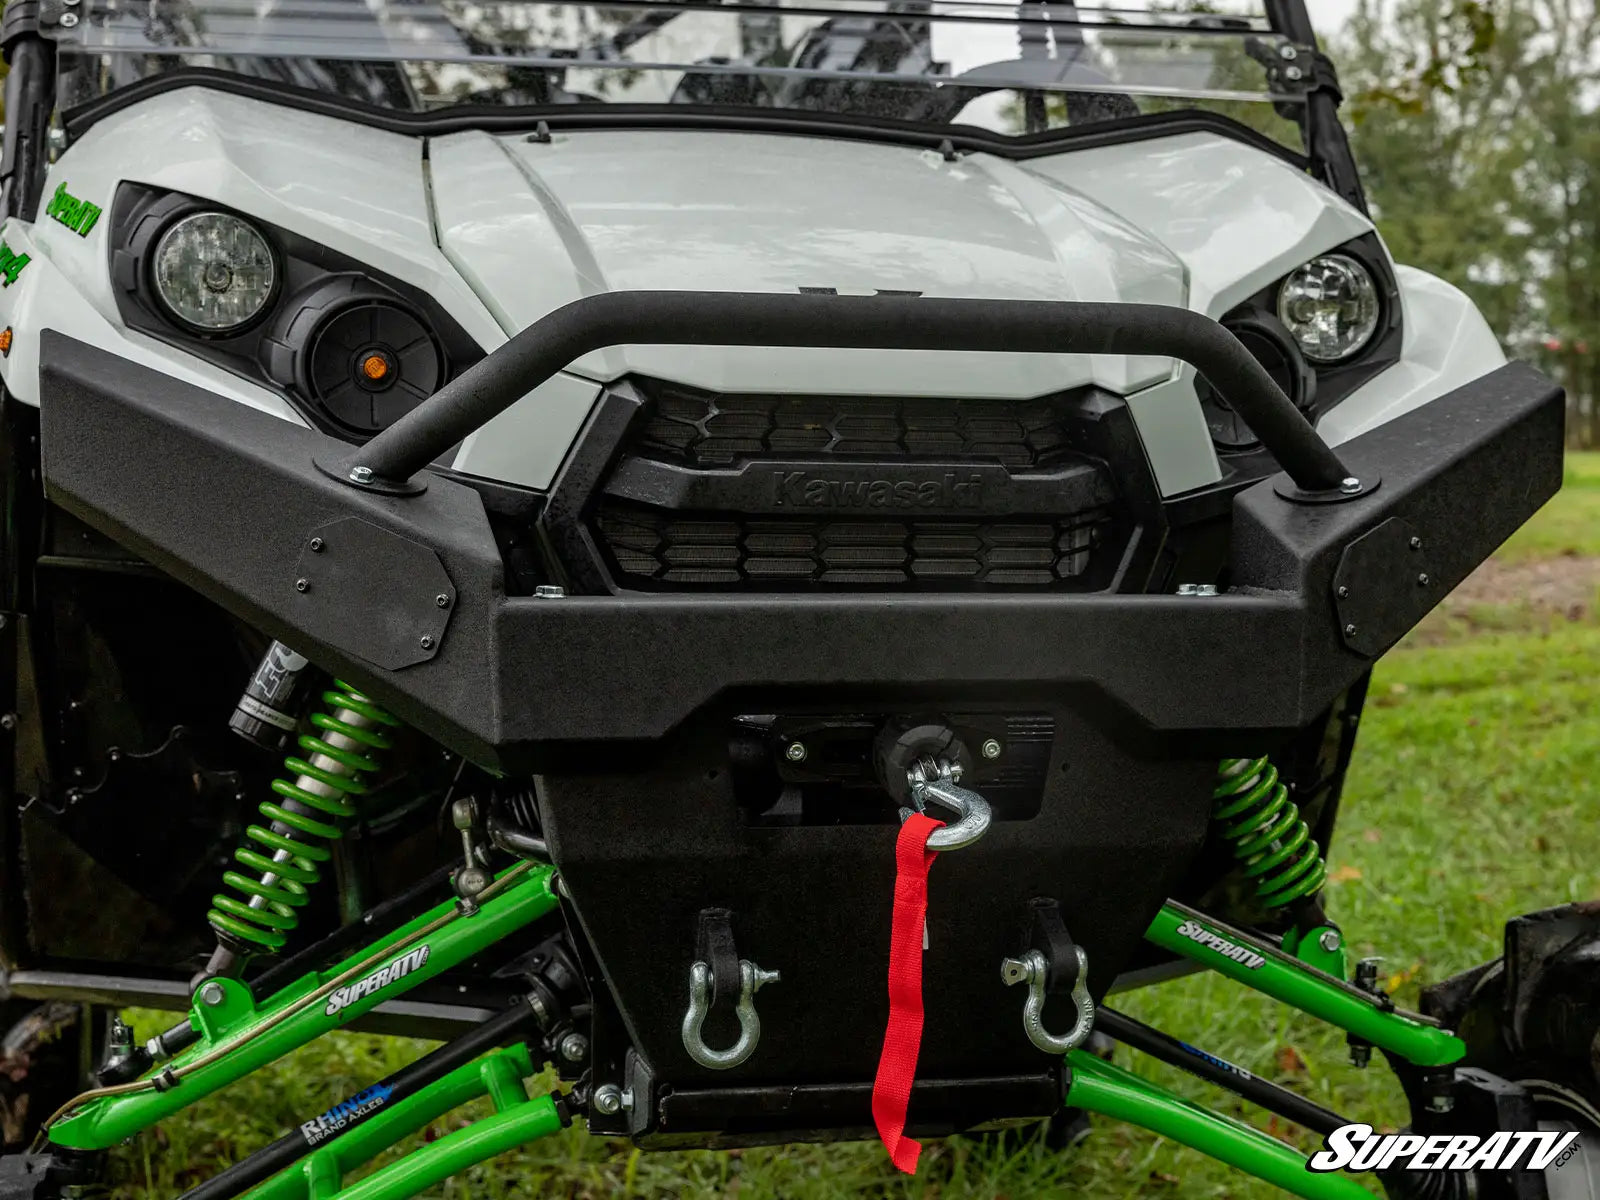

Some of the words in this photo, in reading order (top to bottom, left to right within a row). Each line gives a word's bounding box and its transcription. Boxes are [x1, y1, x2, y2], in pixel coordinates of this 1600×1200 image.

[773, 471, 982, 508] Kawasaki
[307, 1118, 347, 1146] BRAND
[348, 1097, 384, 1122] AXLES
